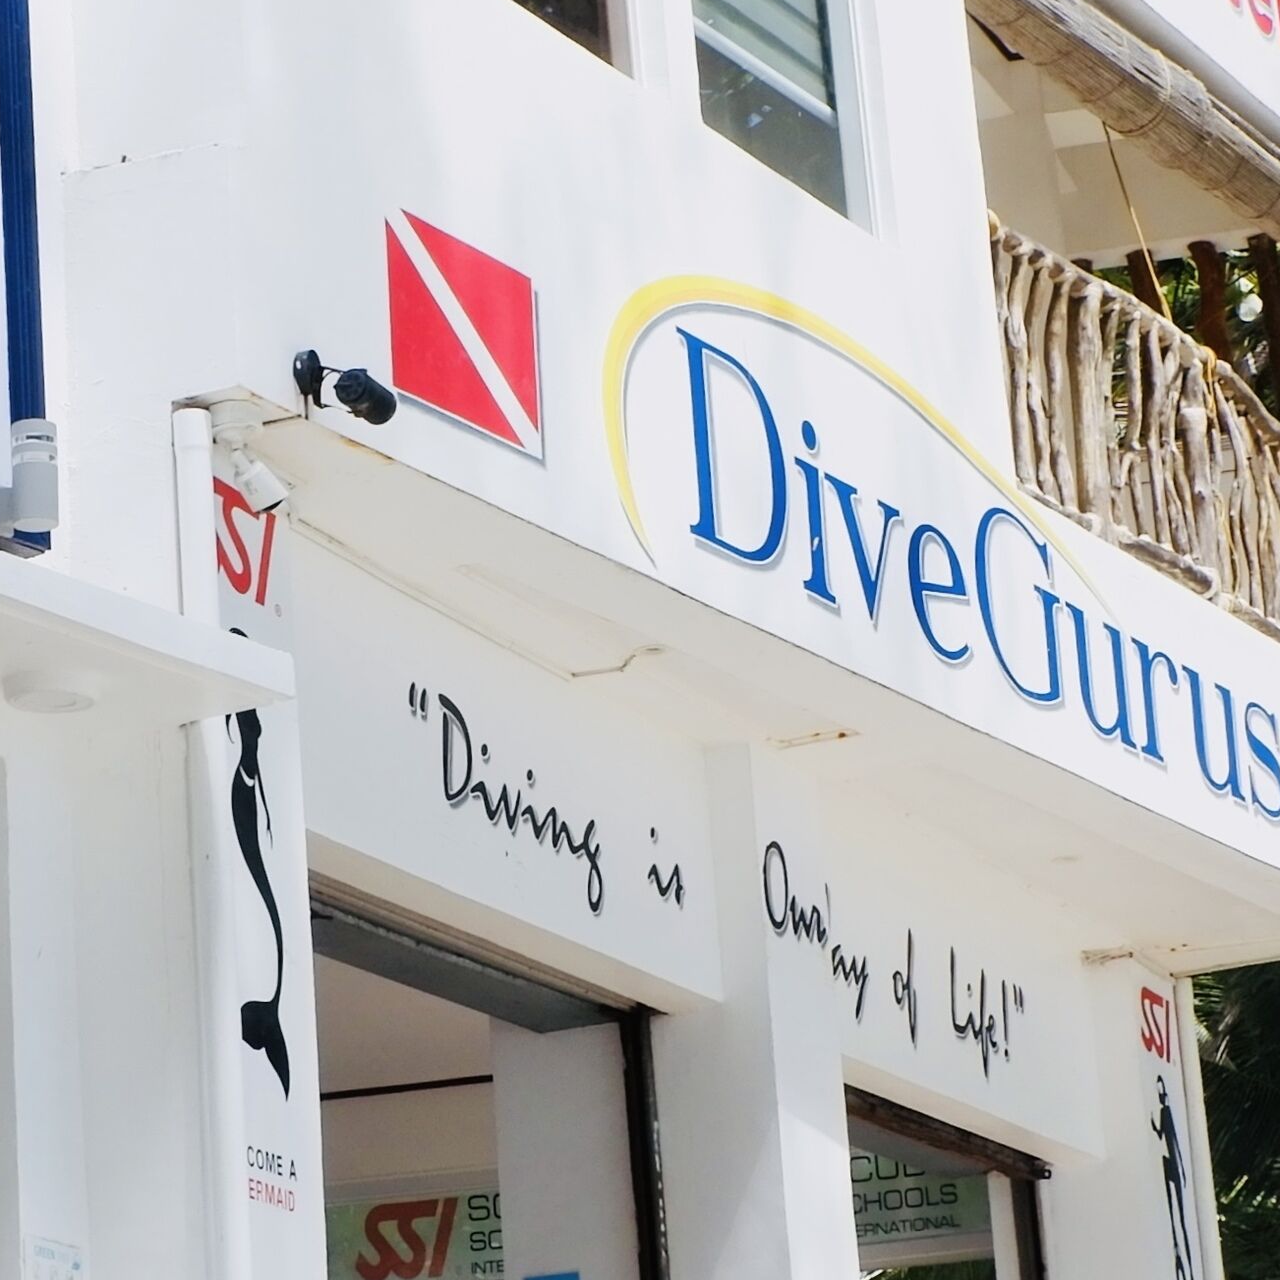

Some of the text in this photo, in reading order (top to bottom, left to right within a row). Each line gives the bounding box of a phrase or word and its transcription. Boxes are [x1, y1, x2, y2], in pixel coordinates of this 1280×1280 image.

[648, 826, 683, 905] is
[893, 928, 917, 1045] of
[1141, 986, 1170, 1063] SSI
[247, 1145, 297, 1182] COME A
[249, 1178, 295, 1211] ERMAID
